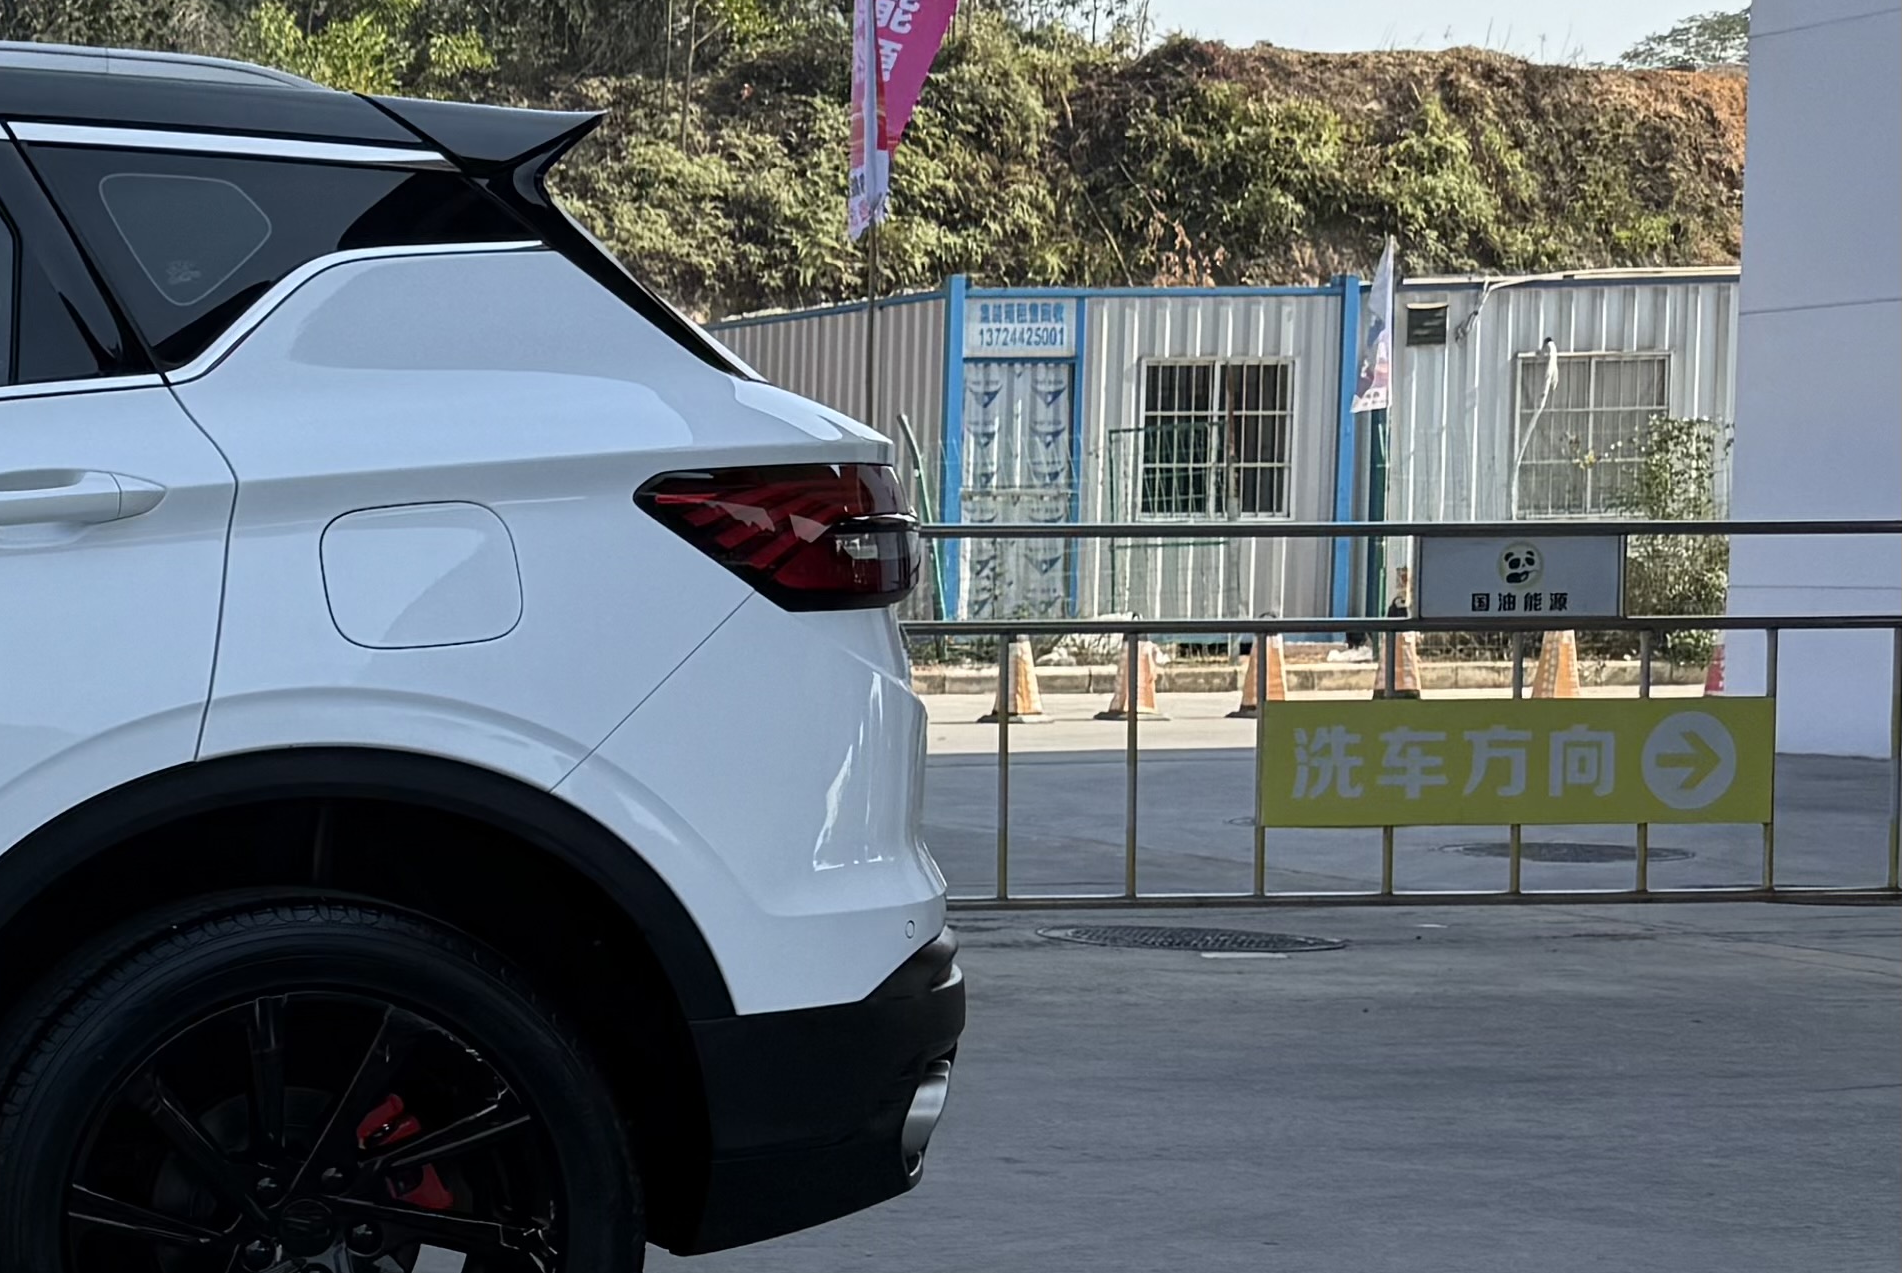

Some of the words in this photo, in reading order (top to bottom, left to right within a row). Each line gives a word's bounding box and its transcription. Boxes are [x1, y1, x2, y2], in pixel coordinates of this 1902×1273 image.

[980, 327, 1064, 346] 13724425001
[1471, 591, 1570, 614] 国油能源
[1292, 724, 1617, 800] 洗车方向
